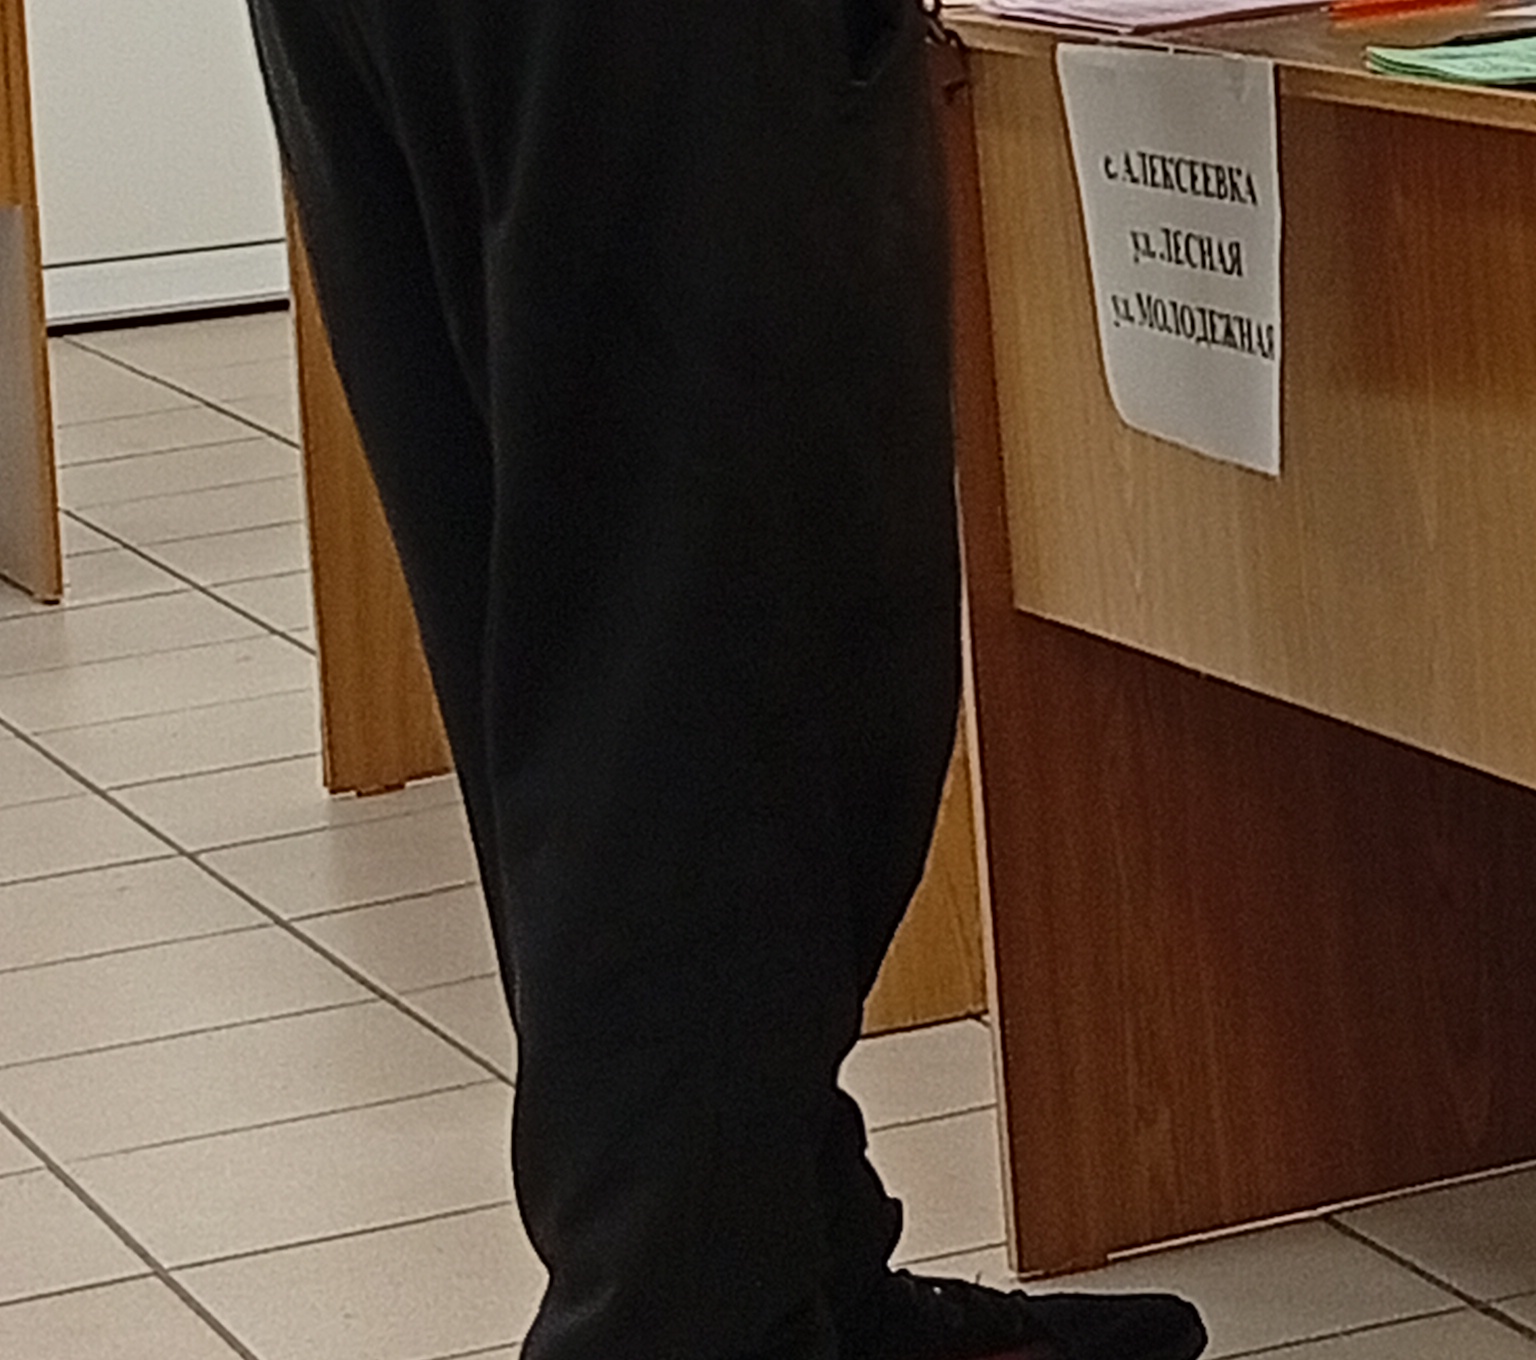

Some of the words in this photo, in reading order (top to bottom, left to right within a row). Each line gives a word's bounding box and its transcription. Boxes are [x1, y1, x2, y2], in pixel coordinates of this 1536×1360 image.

[1121, 150, 1259, 206] АЛЕКСЕЕВКА
[1158, 226, 1244, 278] ЛЕСНАЯ
[1135, 291, 1276, 361] МОЛОДЕЖНАЯ
